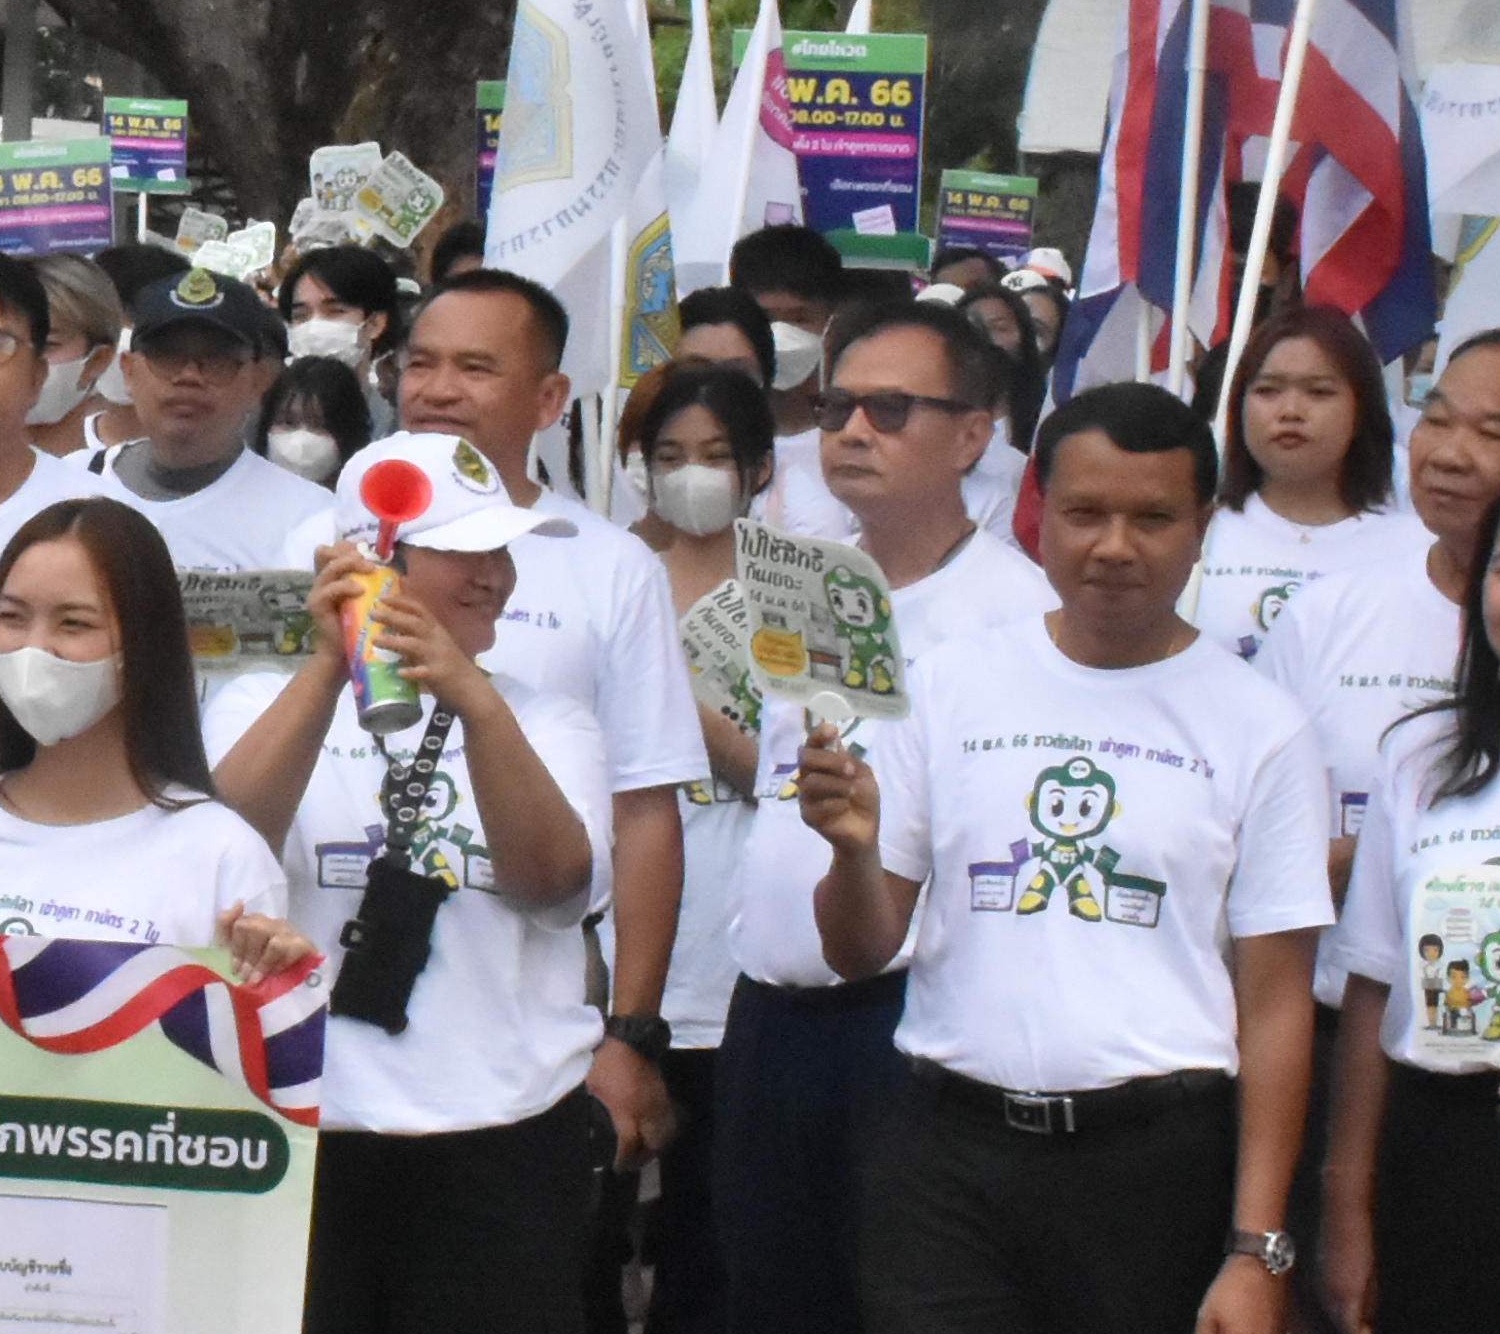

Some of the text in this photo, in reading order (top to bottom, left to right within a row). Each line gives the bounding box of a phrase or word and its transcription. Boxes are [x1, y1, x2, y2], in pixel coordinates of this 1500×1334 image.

[870, 78, 913, 106] 66
[11, 169, 64, 192] พ.ค.
[72, 165, 103, 188] 66
[962, 739, 977, 754] 14
[1012, 734, 1028, 748] 66
[1189, 759, 1200, 773] 2
[1448, 829, 1466, 844] 66
[128, 919, 140, 936] 2
[144, 919, 161, 945] ใบ
